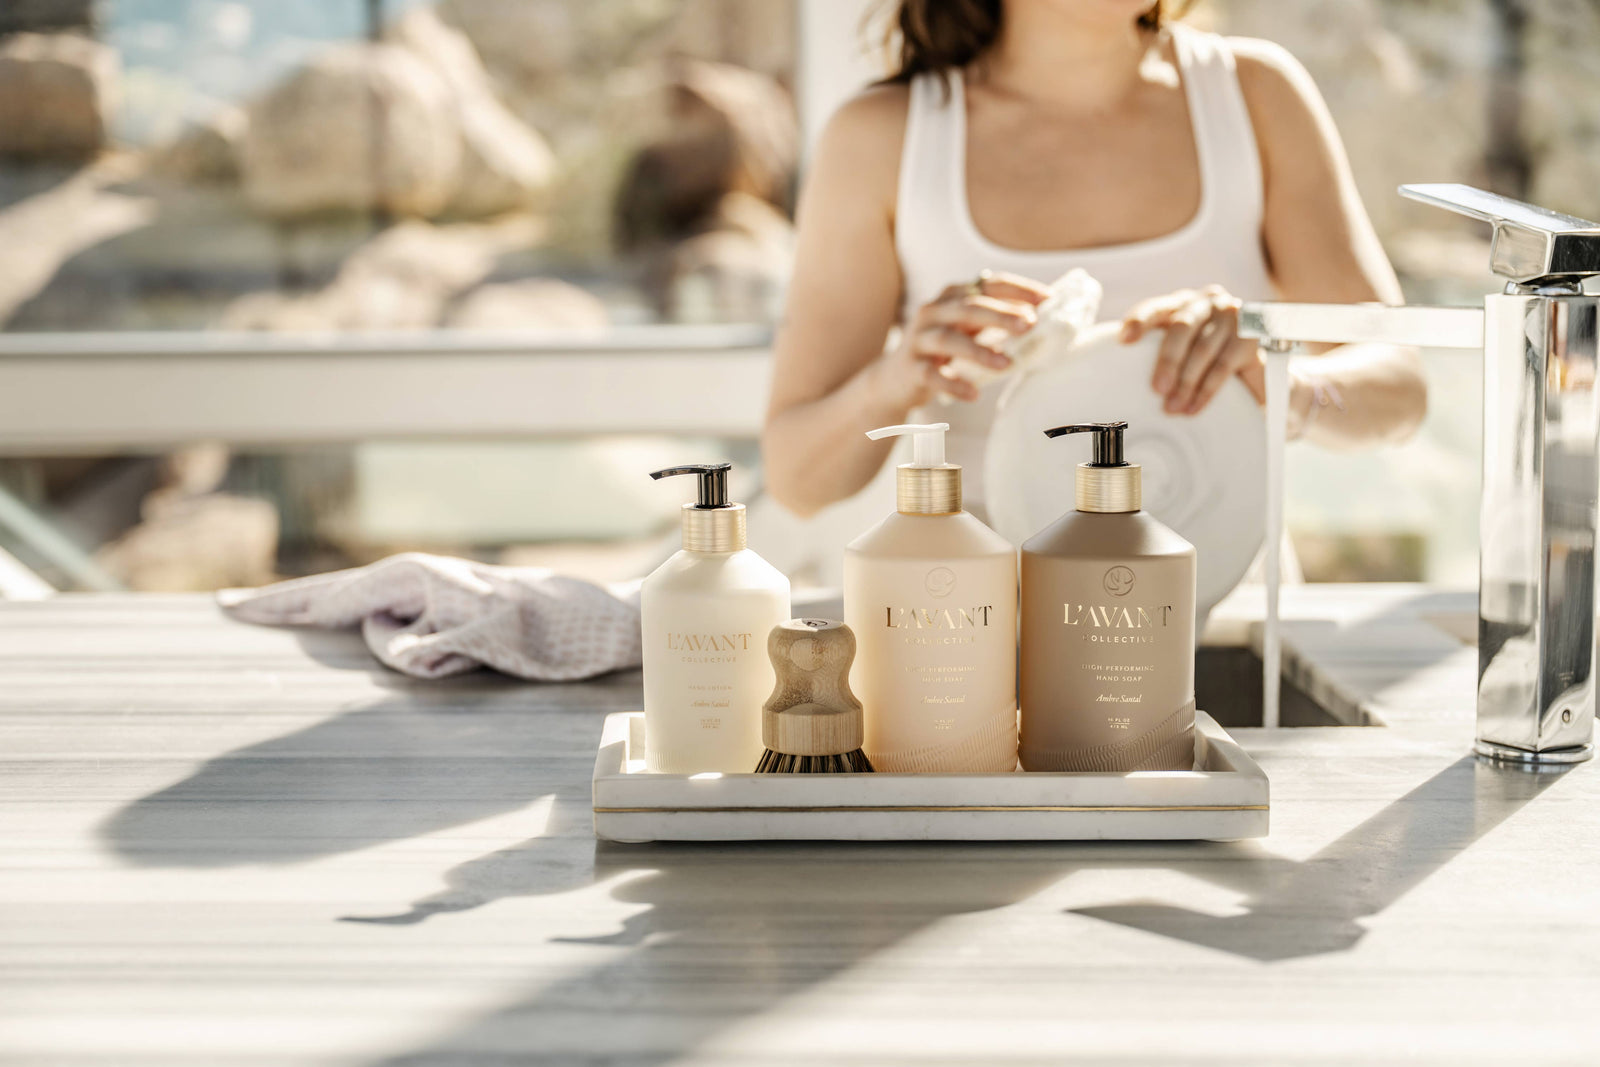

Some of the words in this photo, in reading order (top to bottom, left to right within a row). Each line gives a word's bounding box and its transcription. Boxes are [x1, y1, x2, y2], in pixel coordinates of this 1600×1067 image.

[885, 605, 993, 630] L'AVANT
[1063, 603, 1172, 629] L'AVANT
[667, 632, 752, 652] L'AVANT
[1081, 663, 1103, 671] HIGH
[1105, 664, 1155, 672] PERFORMING
[1096, 674, 1120, 682] HAND
[1095, 693, 1120, 703] Ambre
[1120, 694, 1143, 703] Santal
